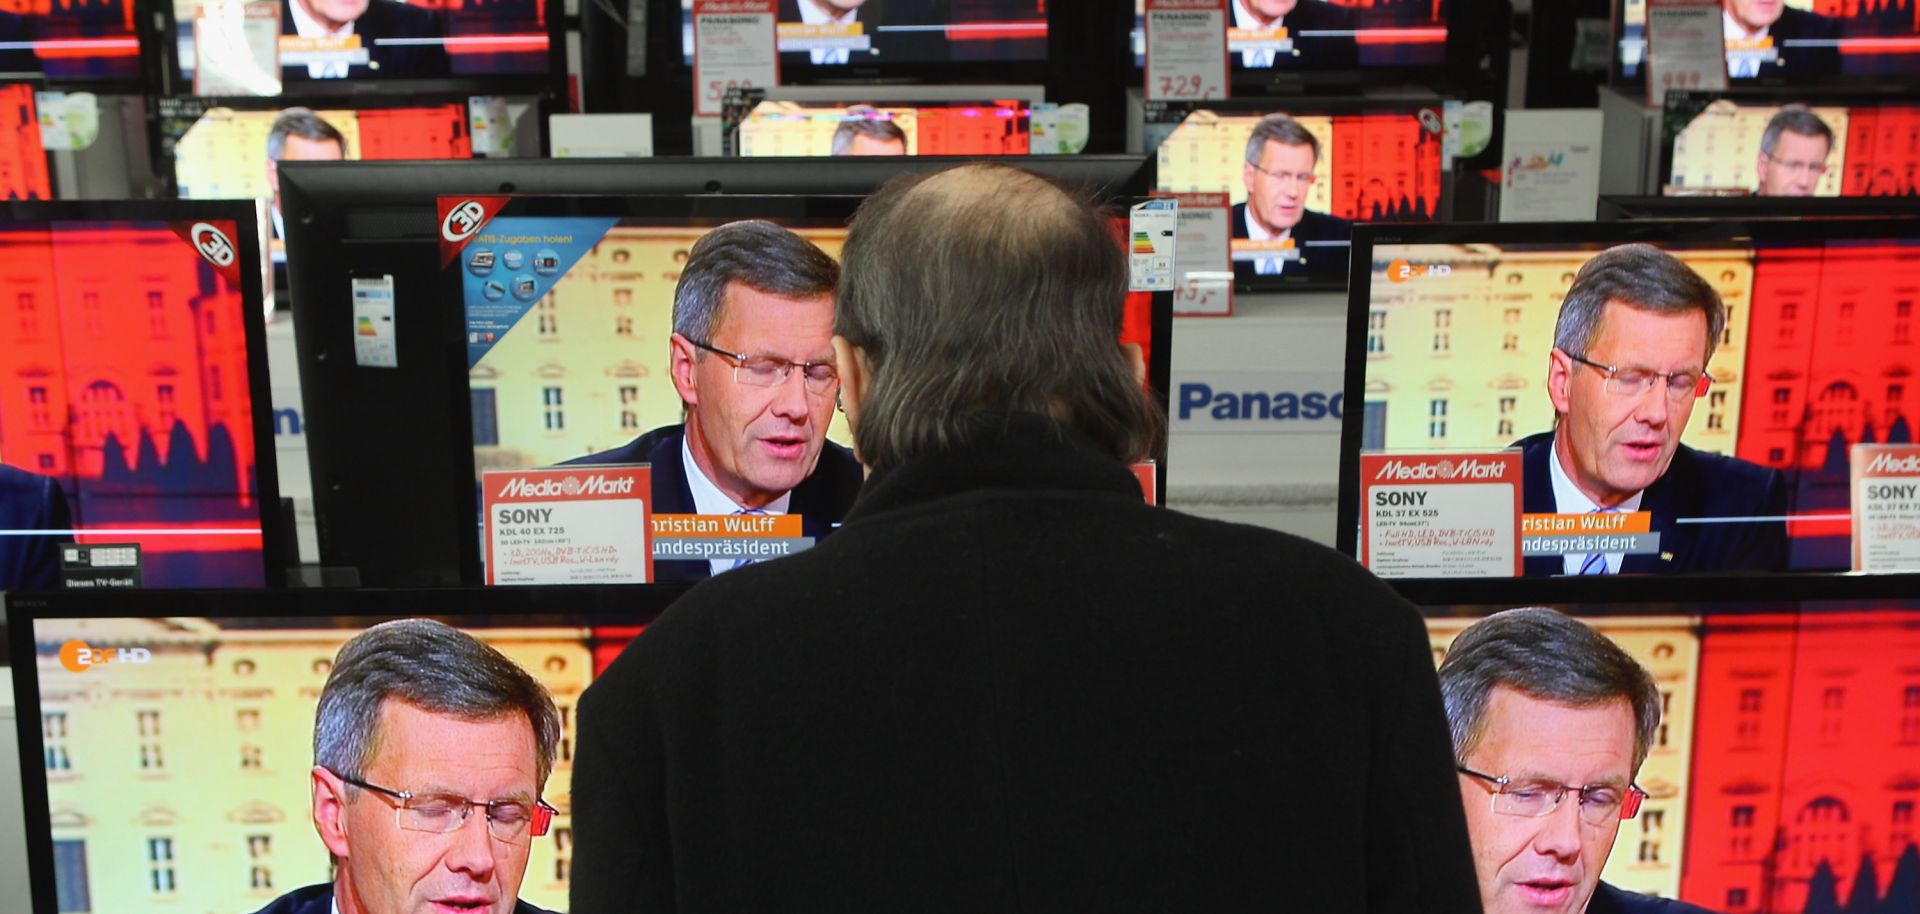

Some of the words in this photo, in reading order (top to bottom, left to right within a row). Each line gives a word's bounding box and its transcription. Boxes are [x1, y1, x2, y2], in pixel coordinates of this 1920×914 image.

[451, 201, 484, 233] 3D
[200, 232, 234, 264] 3D
[1375, 460, 1438, 480] Media
[1450, 459, 1507, 478] Markt
[498, 478, 563, 497] Media
[577, 475, 635, 495] Markt
[1867, 484, 1918, 499] SONY
[1375, 491, 1428, 506] SONY
[499, 508, 553, 525] SONY
[1376, 509, 1394, 517] KDL
[1395, 509, 1406, 517] 37
[1408, 509, 1420, 517] EX
[1422, 509, 1439, 517] 525
[723, 516, 777, 533] Wulff
[1523, 515, 1575, 531] ristian
[1580, 514, 1628, 531] Wulff
[499, 528, 518, 536] KDL
[534, 527, 545, 535] EX
[548, 527, 565, 535] 725
[1523, 535, 1637, 555] ndespräsident
[66, 578, 94, 588] Dieses
